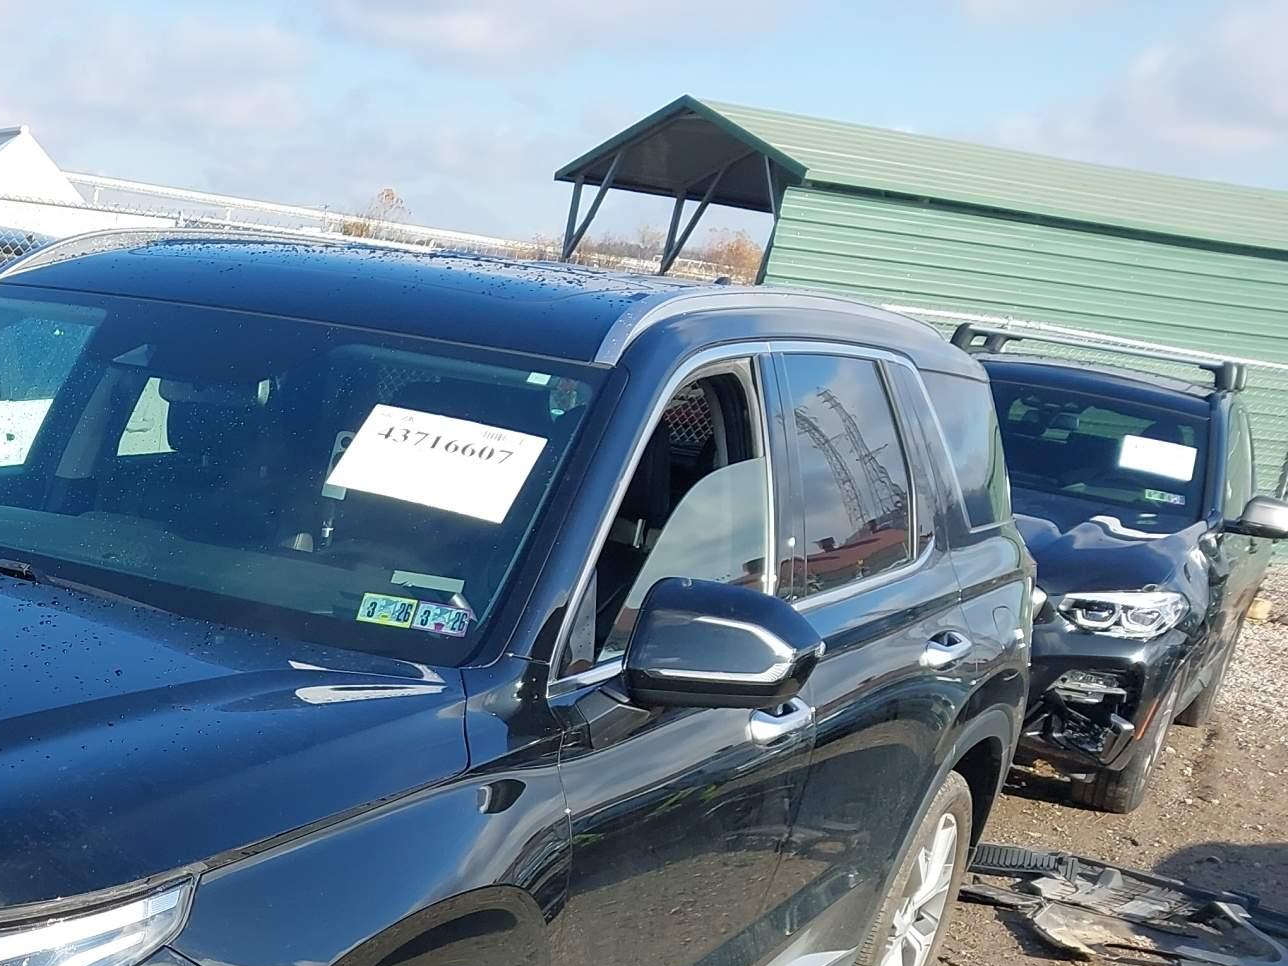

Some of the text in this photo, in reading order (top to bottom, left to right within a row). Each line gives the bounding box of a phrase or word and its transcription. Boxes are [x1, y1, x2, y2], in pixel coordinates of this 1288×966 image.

[377, 426, 513, 464] 43716607
[366, 601, 413, 623] 3 26
[420, 609, 468, 632] 3 26
